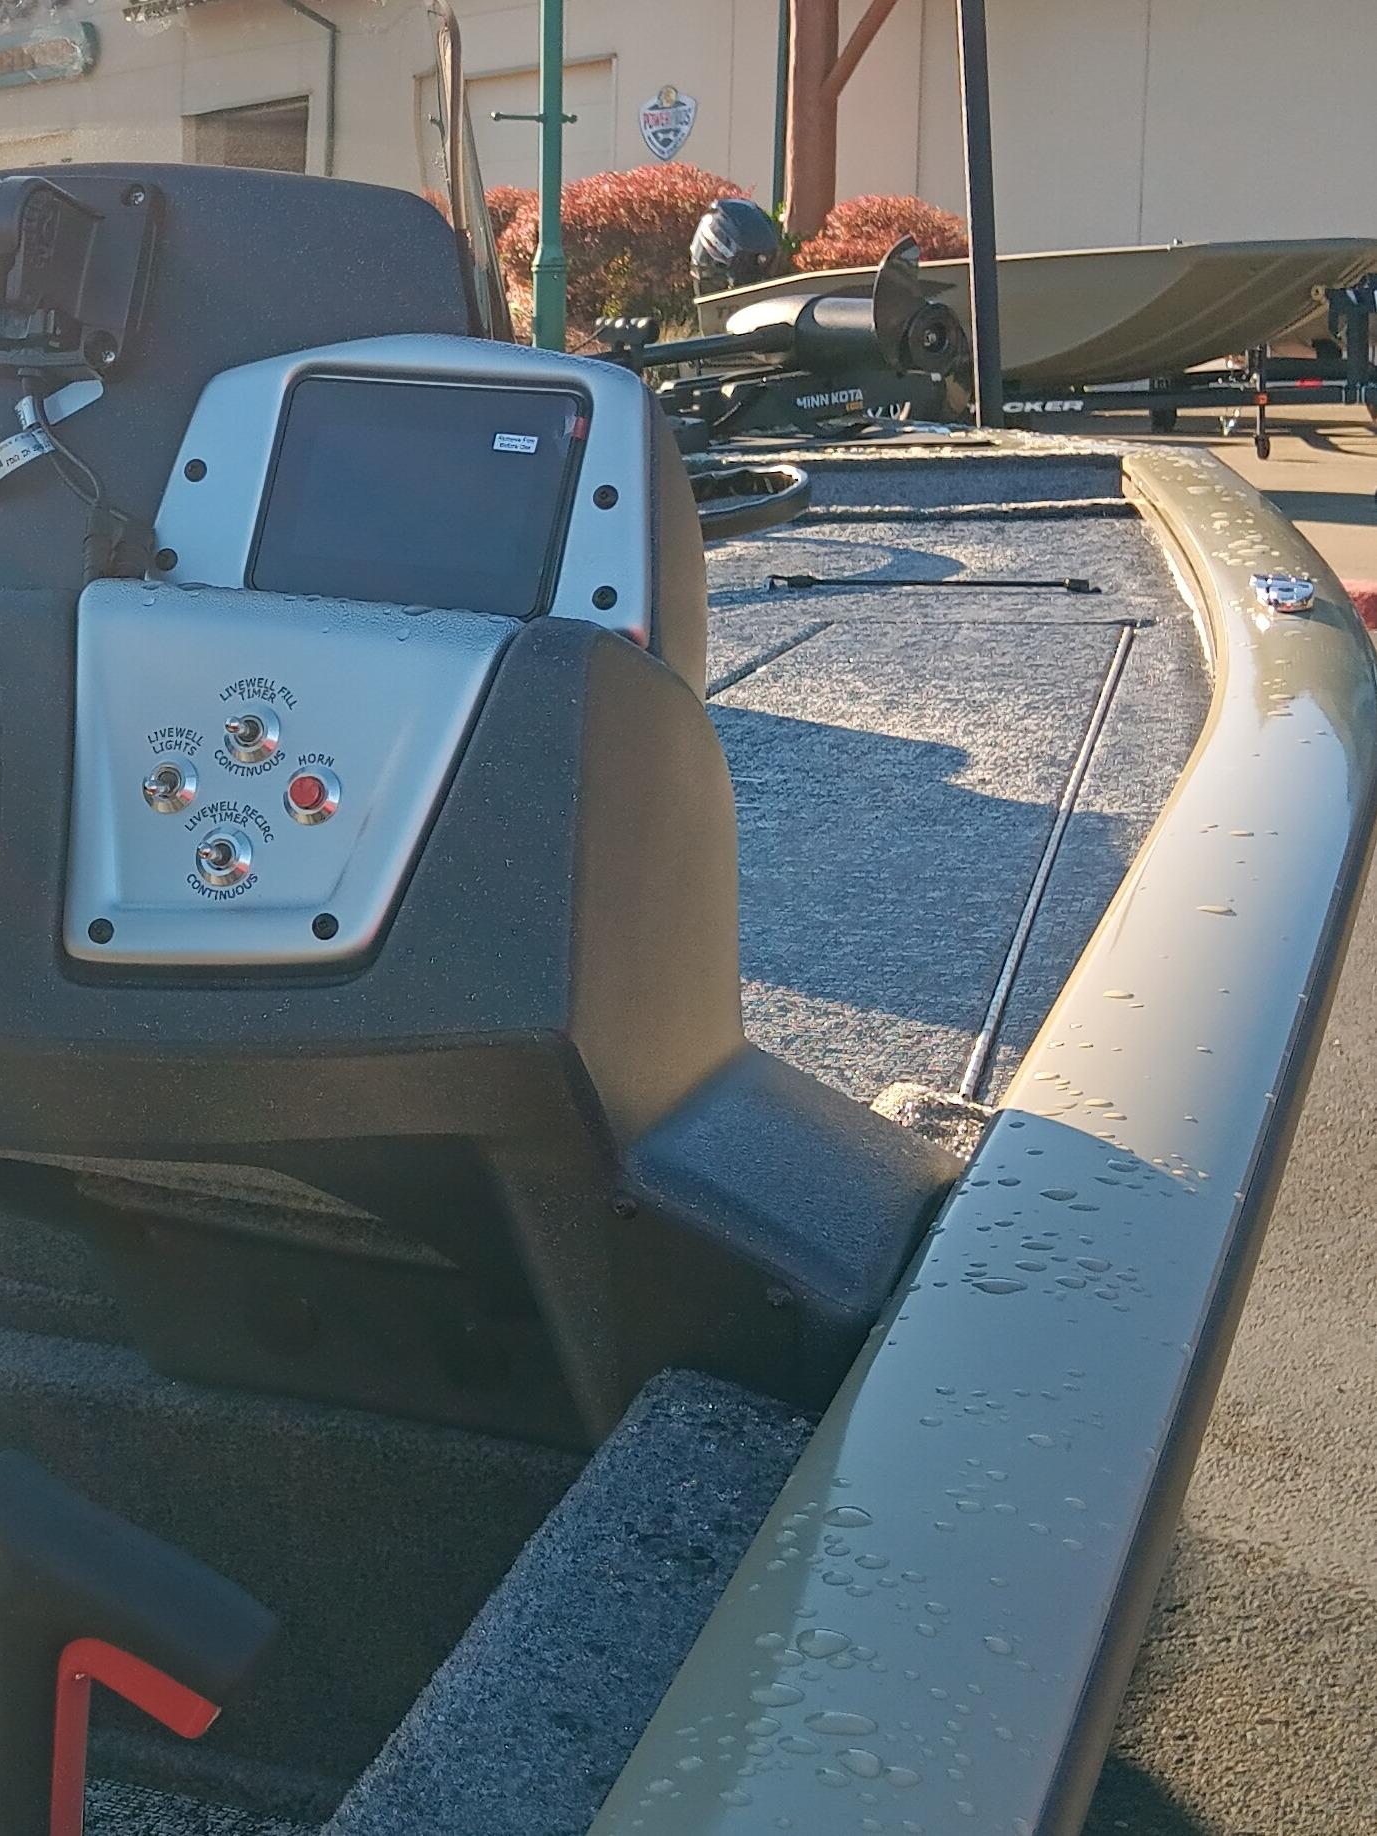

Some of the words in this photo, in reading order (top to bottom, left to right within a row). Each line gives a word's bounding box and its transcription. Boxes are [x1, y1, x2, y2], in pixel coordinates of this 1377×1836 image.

[831, 388, 864, 405] KOTA
[1002, 400, 1084, 413] CKER
[219, 677, 275, 702] LIVEWELL
[277, 686, 298, 711] FILL
[238, 688, 277, 704] TIMER
[147, 726, 205, 747] LIVEWELL
[152, 740, 198, 756] LIGHTS
[214, 749, 286, 777] CONTINUOUS
[298, 753, 335, 767] HORN
[184, 801, 239, 832] LIVEWELL
[242, 805, 274, 843] RECIRC
[210, 812, 250, 828] TIMER
[186, 873, 258, 901] CONTINUOUS
